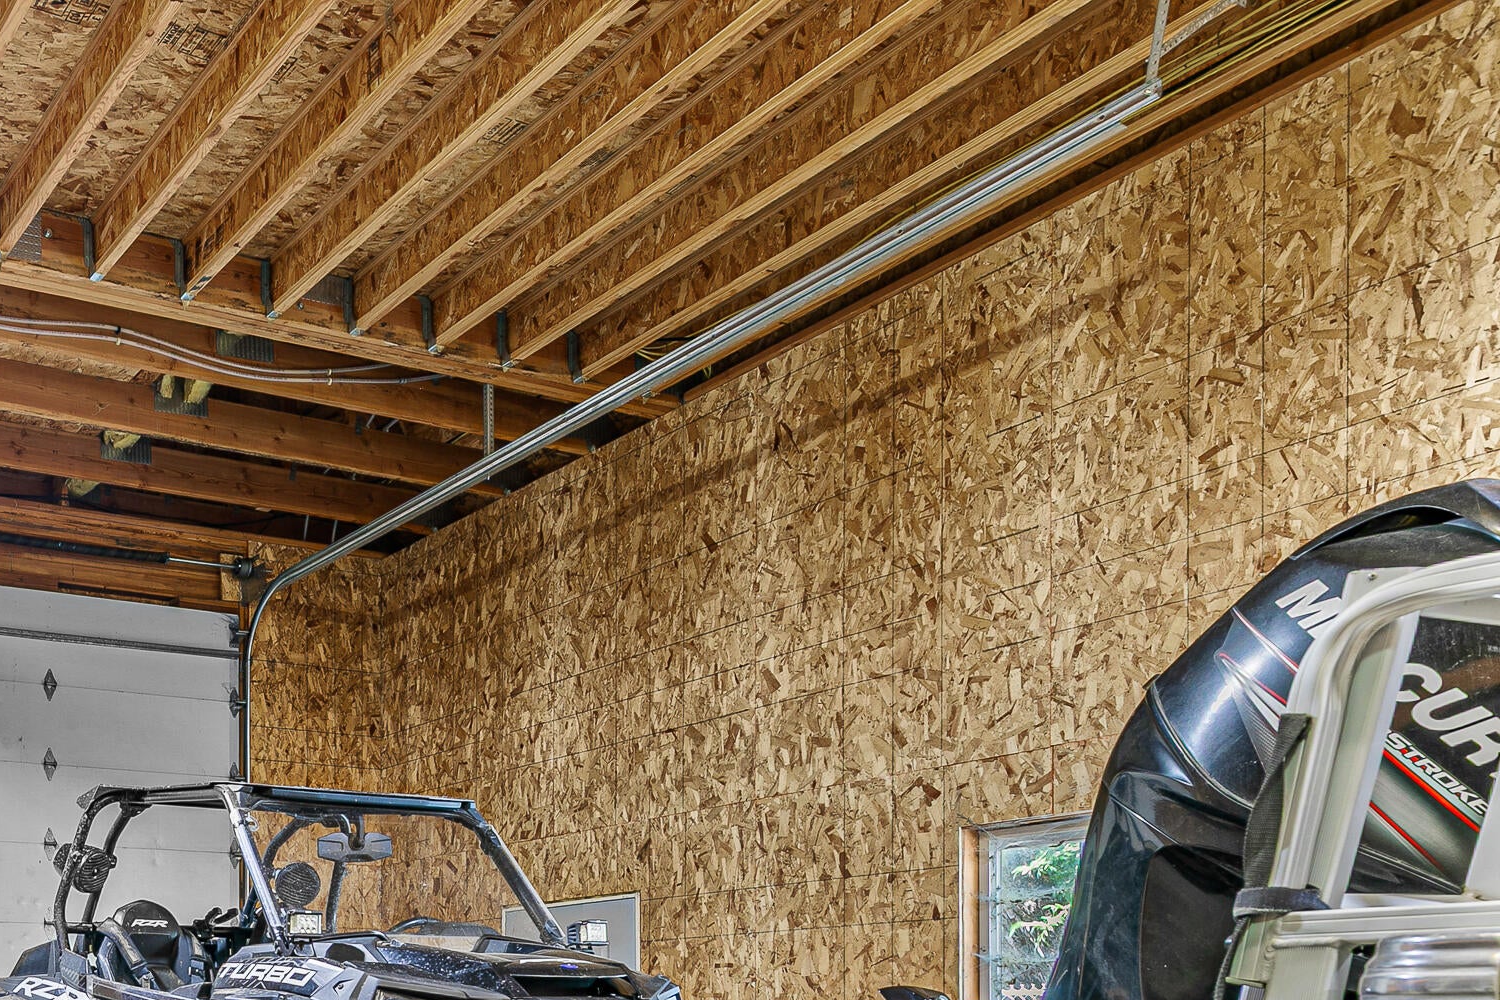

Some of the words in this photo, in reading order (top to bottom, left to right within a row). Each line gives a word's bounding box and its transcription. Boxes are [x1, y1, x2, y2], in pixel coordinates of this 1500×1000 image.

[1384, 729, 1489, 816] STROKE
[131, 918, 170, 929] RZR
[220, 962, 317, 989] TURBO
